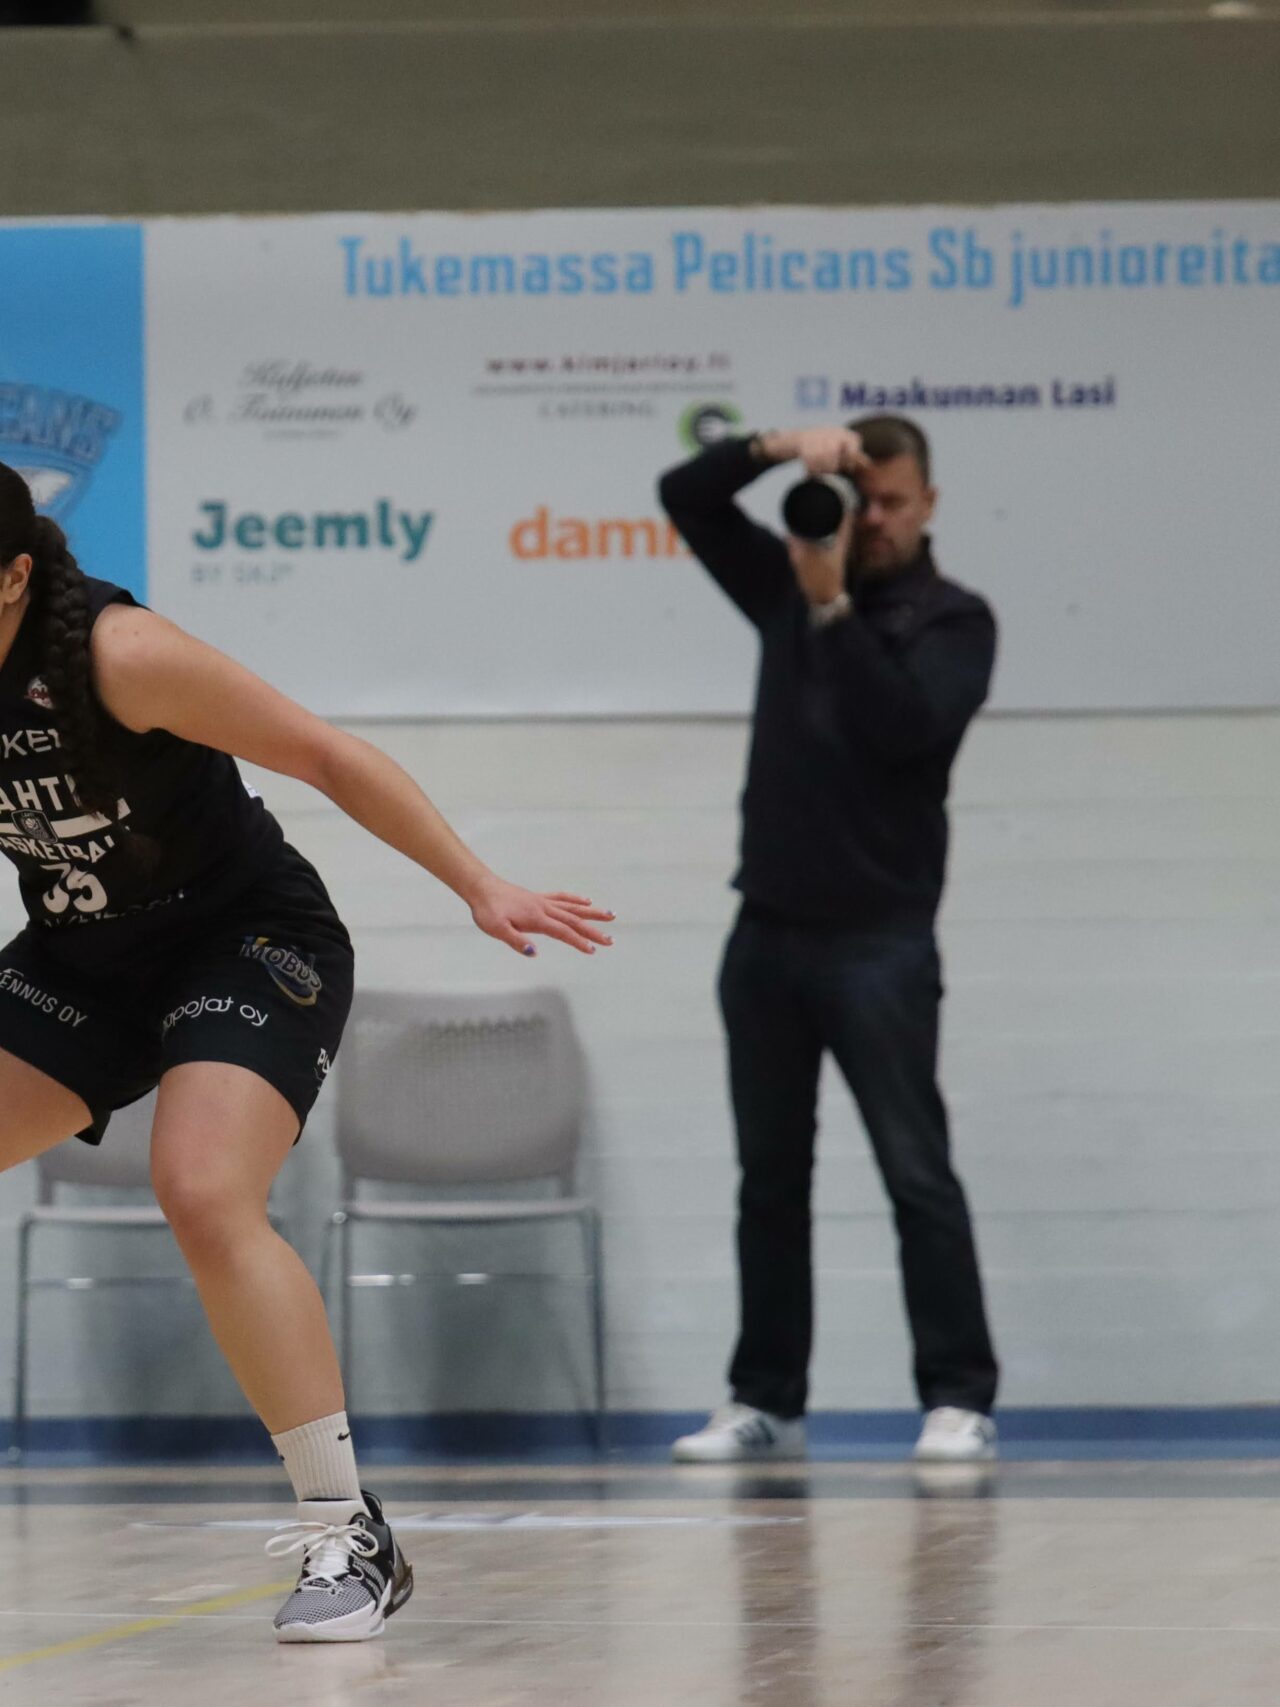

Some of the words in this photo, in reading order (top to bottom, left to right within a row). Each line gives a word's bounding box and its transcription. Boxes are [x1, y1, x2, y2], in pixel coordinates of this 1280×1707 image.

[339, 236, 654, 297] Tukemassa
[672, 231, 912, 293] Pelicans
[928, 228, 995, 289] Sb
[1008, 228, 1280, 308] junioreita
[840, 376, 1040, 410] Maakunnan
[1051, 374, 1116, 407] Lasi
[192, 499, 435, 562] Jeemly
[508, 503, 694, 561] dam
[40, 862, 108, 914] 35
[58, 1005, 88, 1028] OY
[163, 996, 234, 1028] apojat
[239, 1004, 268, 1027] oy
